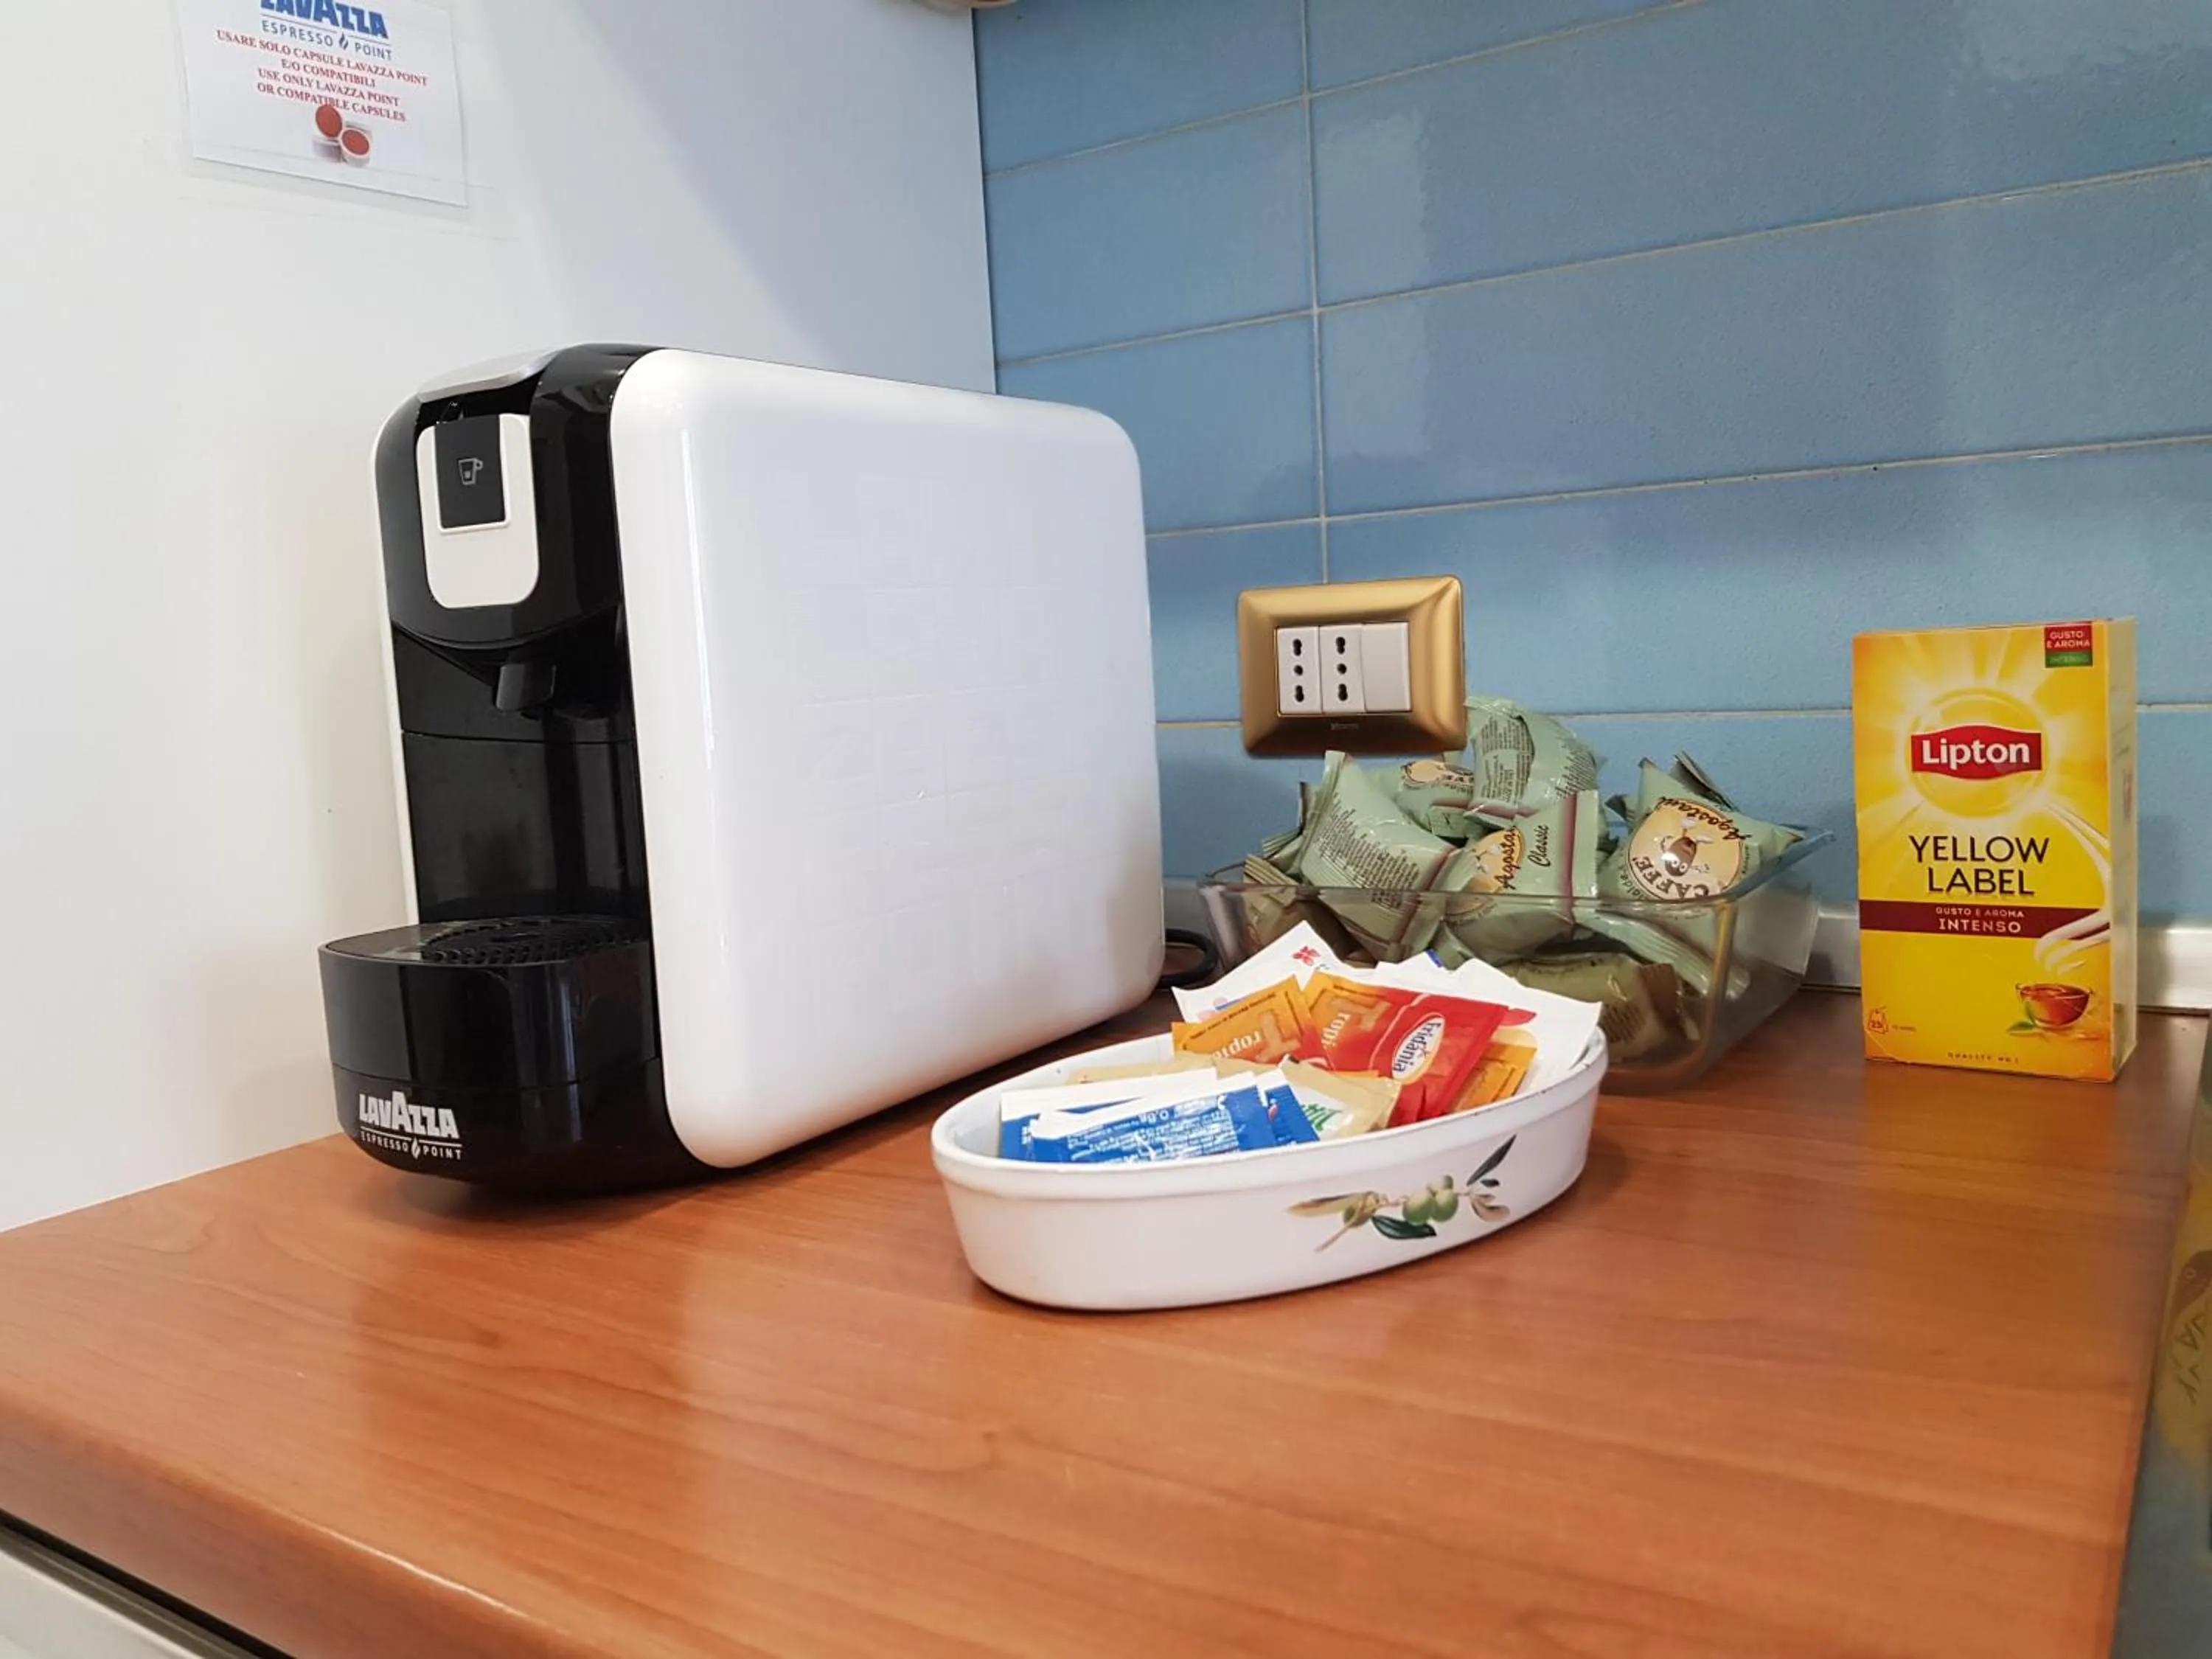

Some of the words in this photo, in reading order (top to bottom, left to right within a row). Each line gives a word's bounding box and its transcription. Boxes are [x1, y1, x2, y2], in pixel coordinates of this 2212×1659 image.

[262, 20, 334, 47] ESPRESSO
[354, 42, 392, 60] POINT
[217, 29, 257, 48] USARE
[259, 40, 291, 55] SOLO
[294, 48, 344, 67] CAPSULE
[347, 60, 395, 80] LAVAZZA
[396, 71, 428, 86] POINT
[258, 68, 280, 81] USE
[282, 74, 314, 88] ONLY
[316, 80, 366, 100] LAVAZZA
[366, 91, 400, 107] POINT
[303, 64, 376, 88] COMPATIBILI
[257, 82, 275, 95] OR
[276, 86, 350, 110] COMPATIBLE
[352, 102, 407, 122] CAPSULES
[2050, 630, 2084, 639] GUSTO
[2054, 639, 2090, 648] AROMA
[1921, 737, 2030, 771] Lipton
[1527, 824, 1551, 868] Classic
[1908, 835, 2050, 863] YELLOW
[1927, 866, 2036, 895] LABEL
[1935, 906, 1972, 916] GUSTO
[1975, 908, 1981, 917] E
[1984, 909, 2025, 918] AROMA
[1938, 918, 2022, 933] INTENSO
[1392, 1021, 1442, 1073] Eridania
[359, 1091, 460, 1139] LAVAZZA
[361, 1130, 408, 1152] ESPRESSO
[422, 1144, 462, 1160] POINT
